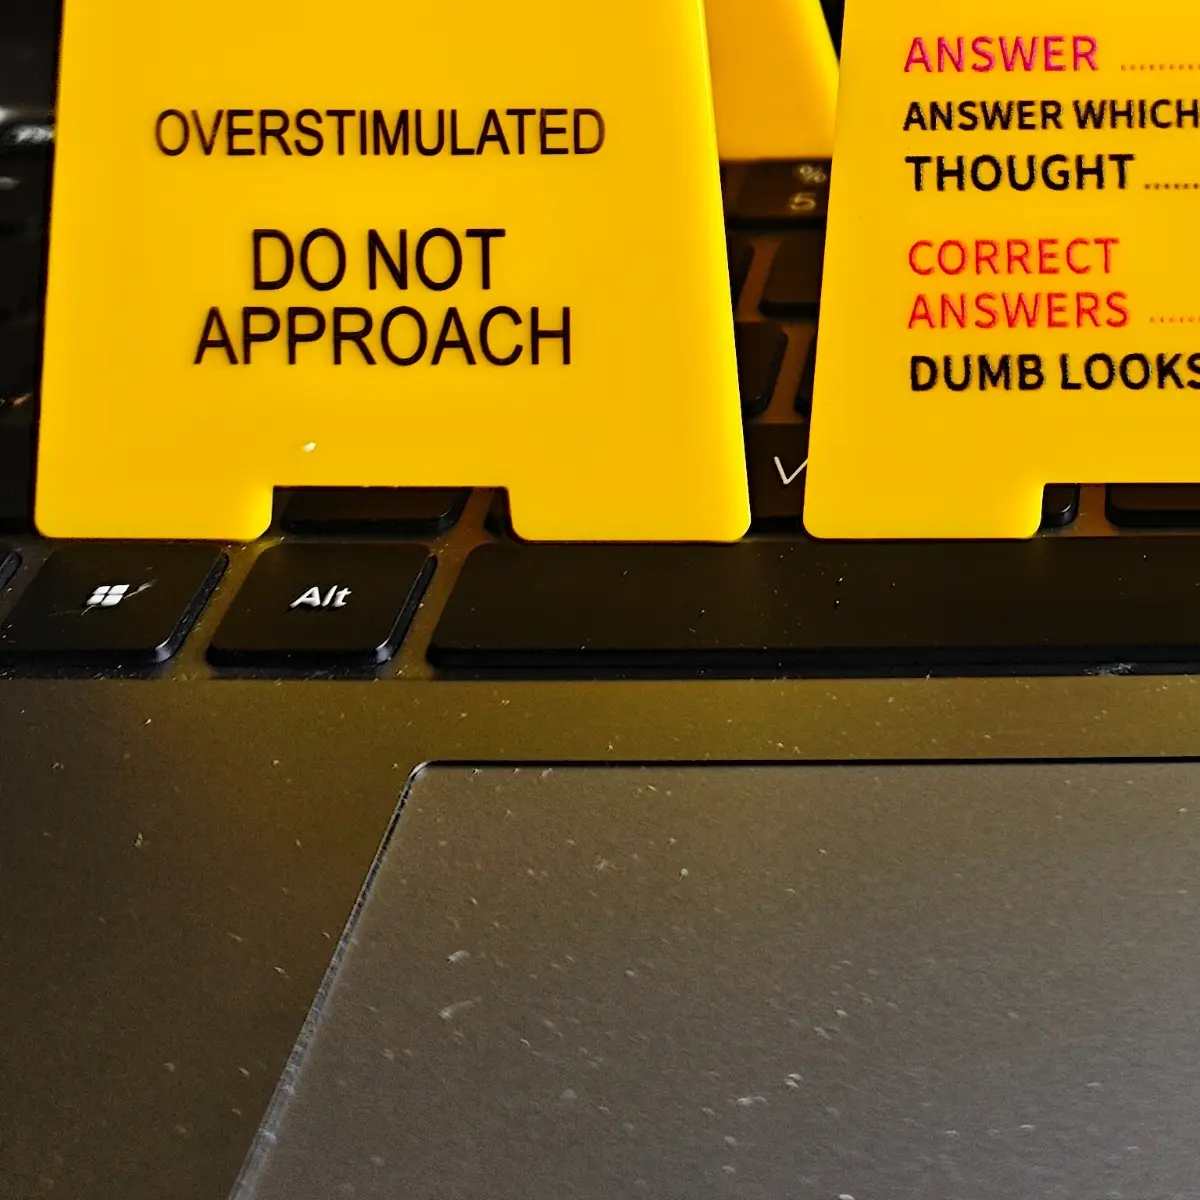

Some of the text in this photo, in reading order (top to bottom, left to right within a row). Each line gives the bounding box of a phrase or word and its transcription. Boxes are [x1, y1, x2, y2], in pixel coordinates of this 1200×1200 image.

[904, 36, 1098, 72] ANSWER
[155, 108, 605, 157] OVERSTIMULATED
[903, 100, 1063, 131] ANSWER
[1072, 99, 1200, 130] WHICH
[905, 154, 1135, 191] THOUGHT
[790, 192, 816, 211] 5
[252, 228, 506, 291] DO NOT
[908, 238, 1119, 275] CORRECT
[908, 291, 1129, 329] ANSWERS
[193, 306, 570, 366] APPROACH
[910, 354, 1044, 392] DUMB
[289, 585, 352, 608] Alt
